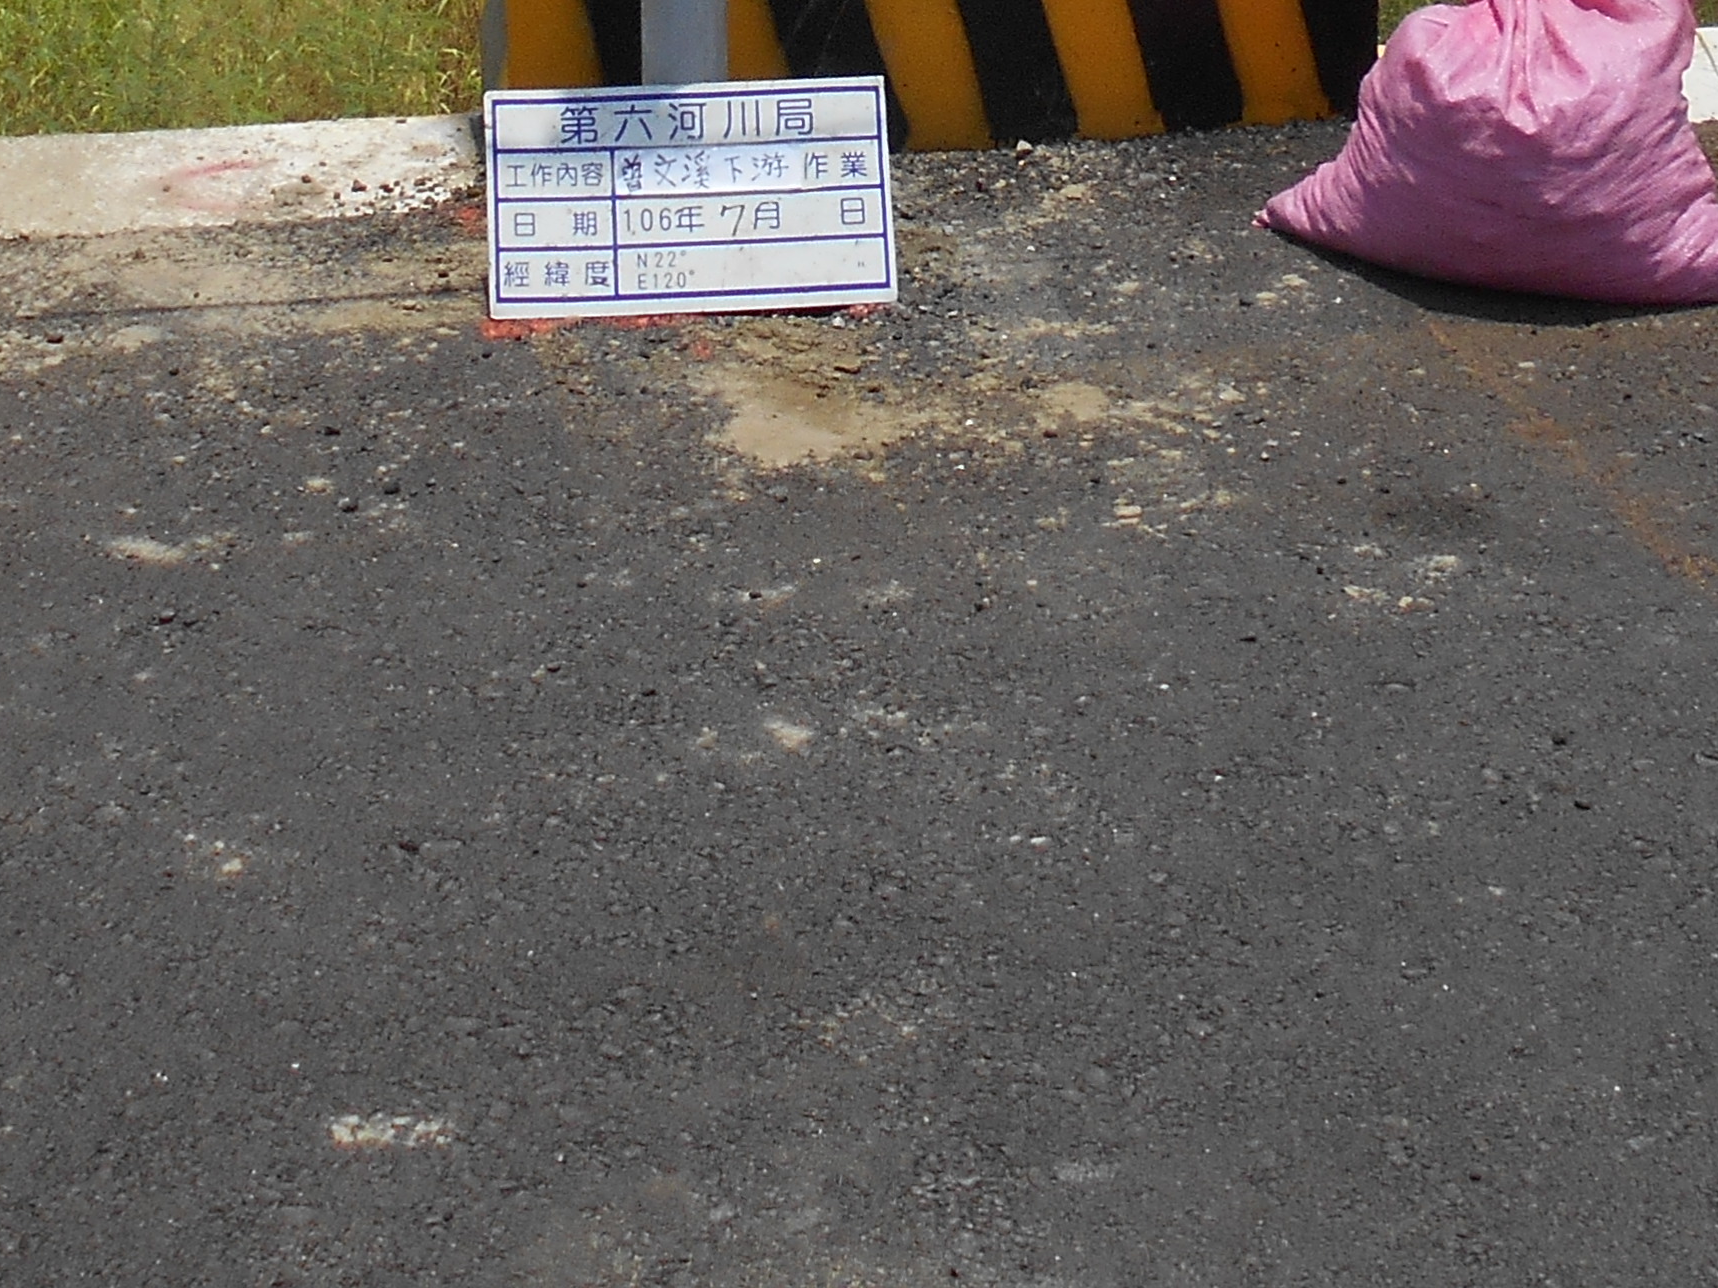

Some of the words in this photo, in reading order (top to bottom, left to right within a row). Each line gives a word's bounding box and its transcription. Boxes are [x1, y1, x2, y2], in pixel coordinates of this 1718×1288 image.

[560, 99, 814, 144] 第六河川局
[505, 162, 604, 188] 工作內容
[504, 260, 613, 288] 經緯度
